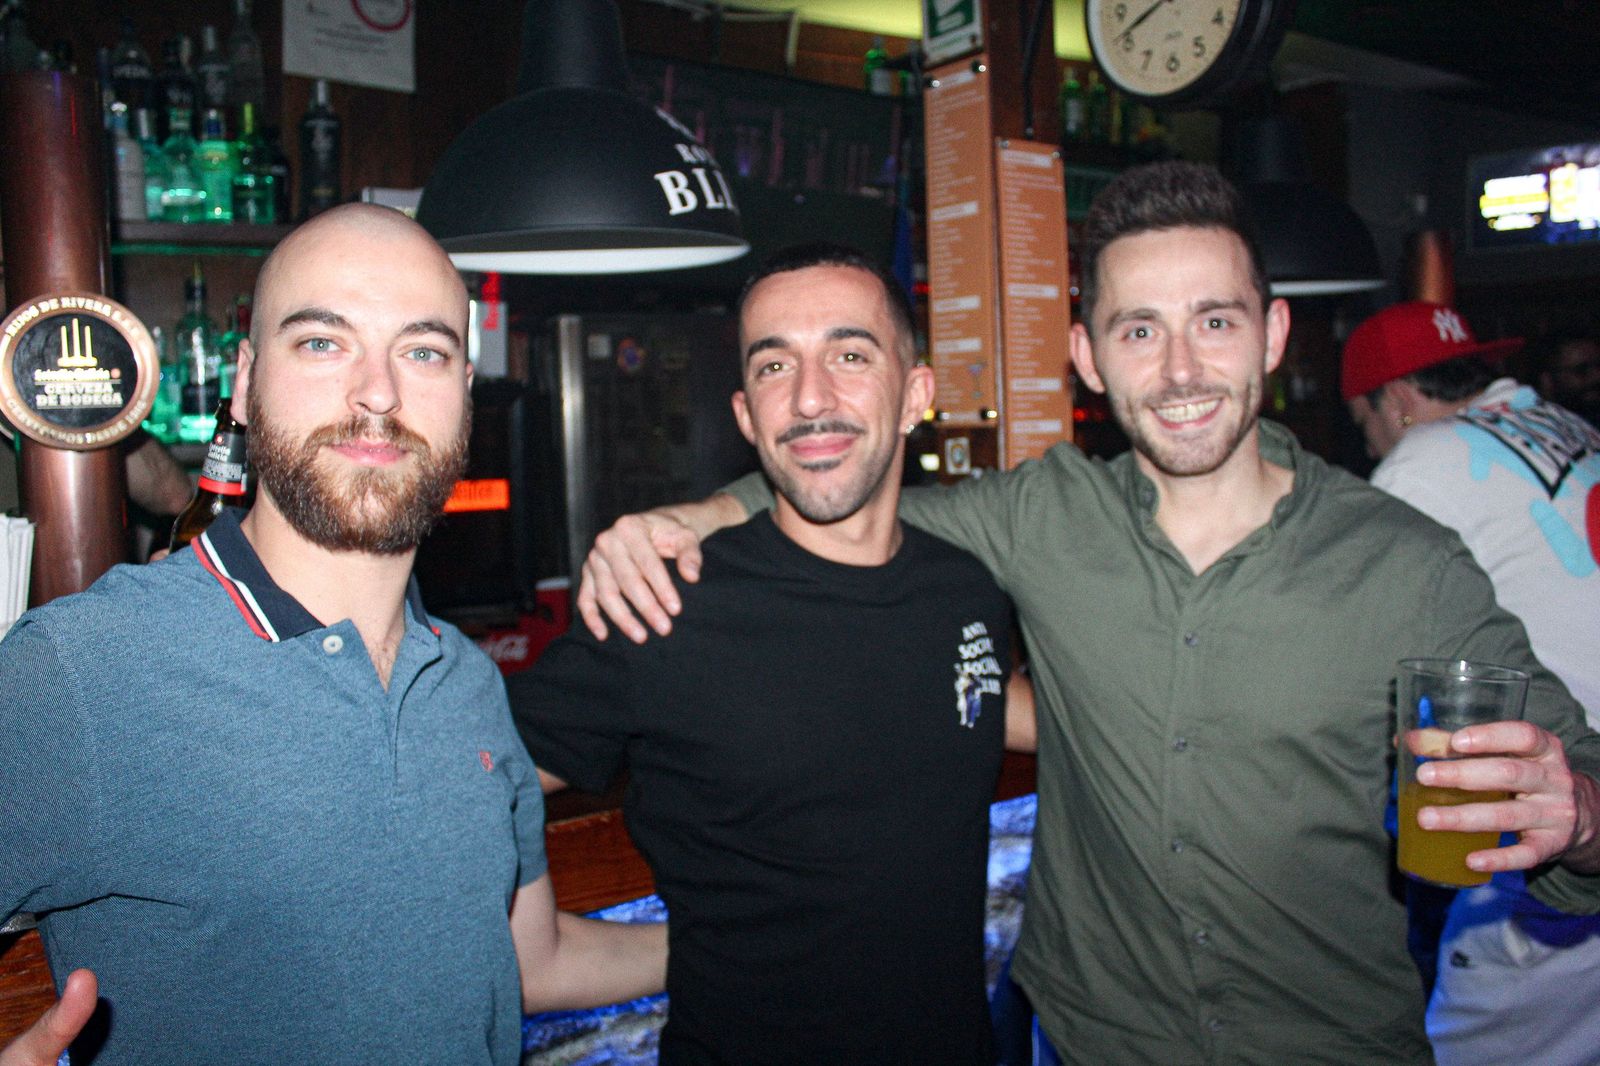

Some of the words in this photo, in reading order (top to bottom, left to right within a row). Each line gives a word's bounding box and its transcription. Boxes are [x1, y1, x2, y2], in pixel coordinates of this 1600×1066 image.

[1193, 35, 1206, 57] 5
[1166, 51, 1180, 72] 6
[38, 298, 59, 313] DE
[61, 297, 112, 317] RIVERA
[44, 382, 113, 395] CERVEZA
[36, 394, 58, 406] DE
[60, 392, 122, 406] BODEGA
